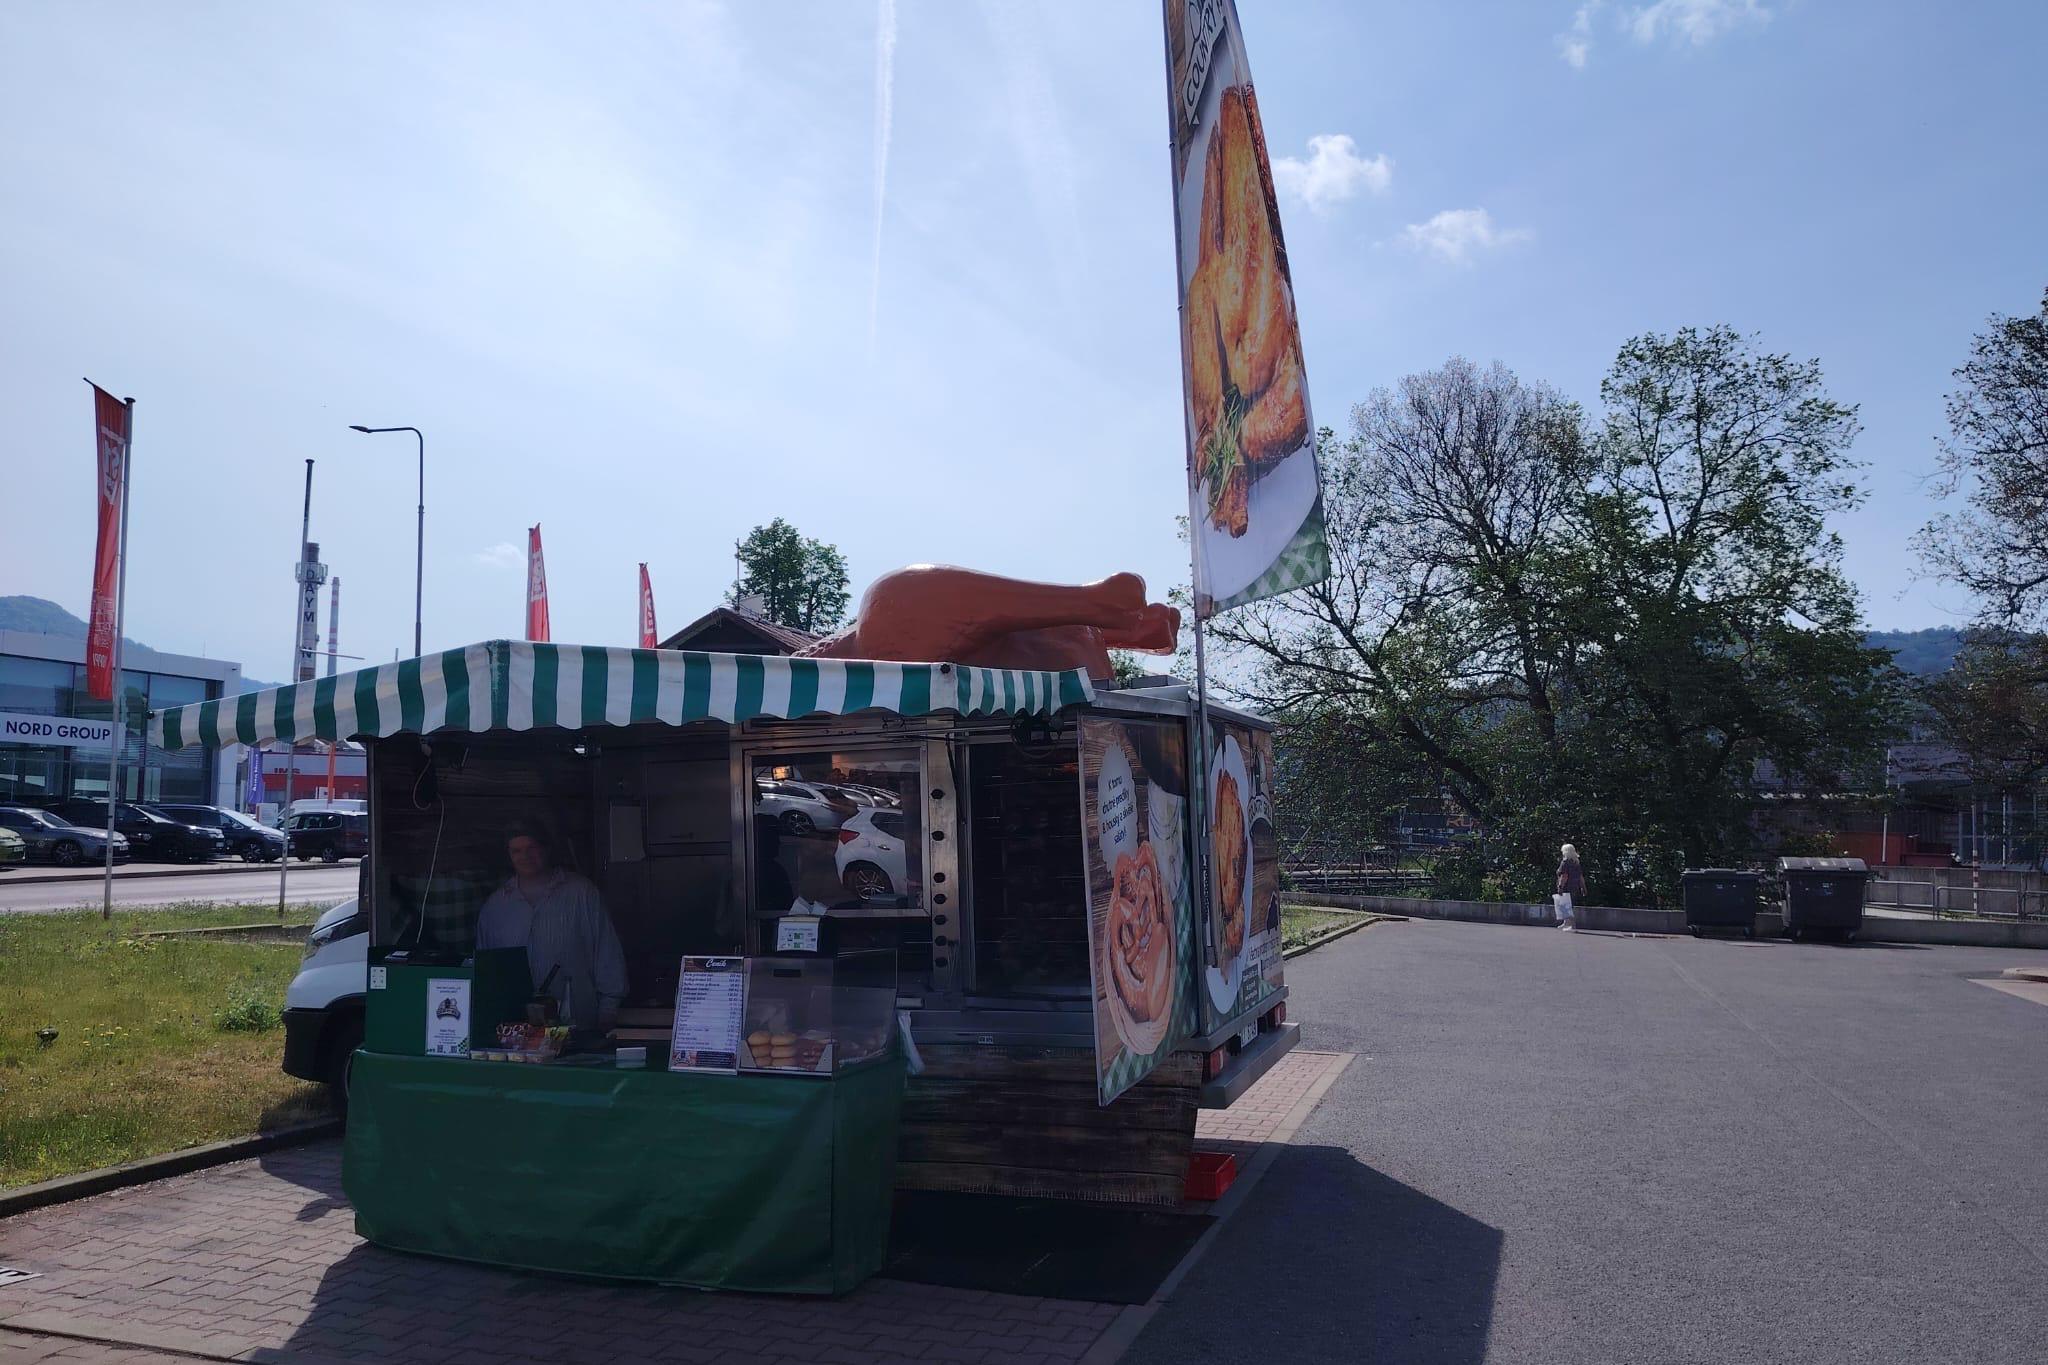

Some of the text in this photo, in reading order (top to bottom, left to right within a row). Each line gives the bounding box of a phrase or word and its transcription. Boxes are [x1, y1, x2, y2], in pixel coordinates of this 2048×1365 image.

[1187, 0, 1217, 107] COUNTRY
[6, 720, 110, 740] NORD GROUP
